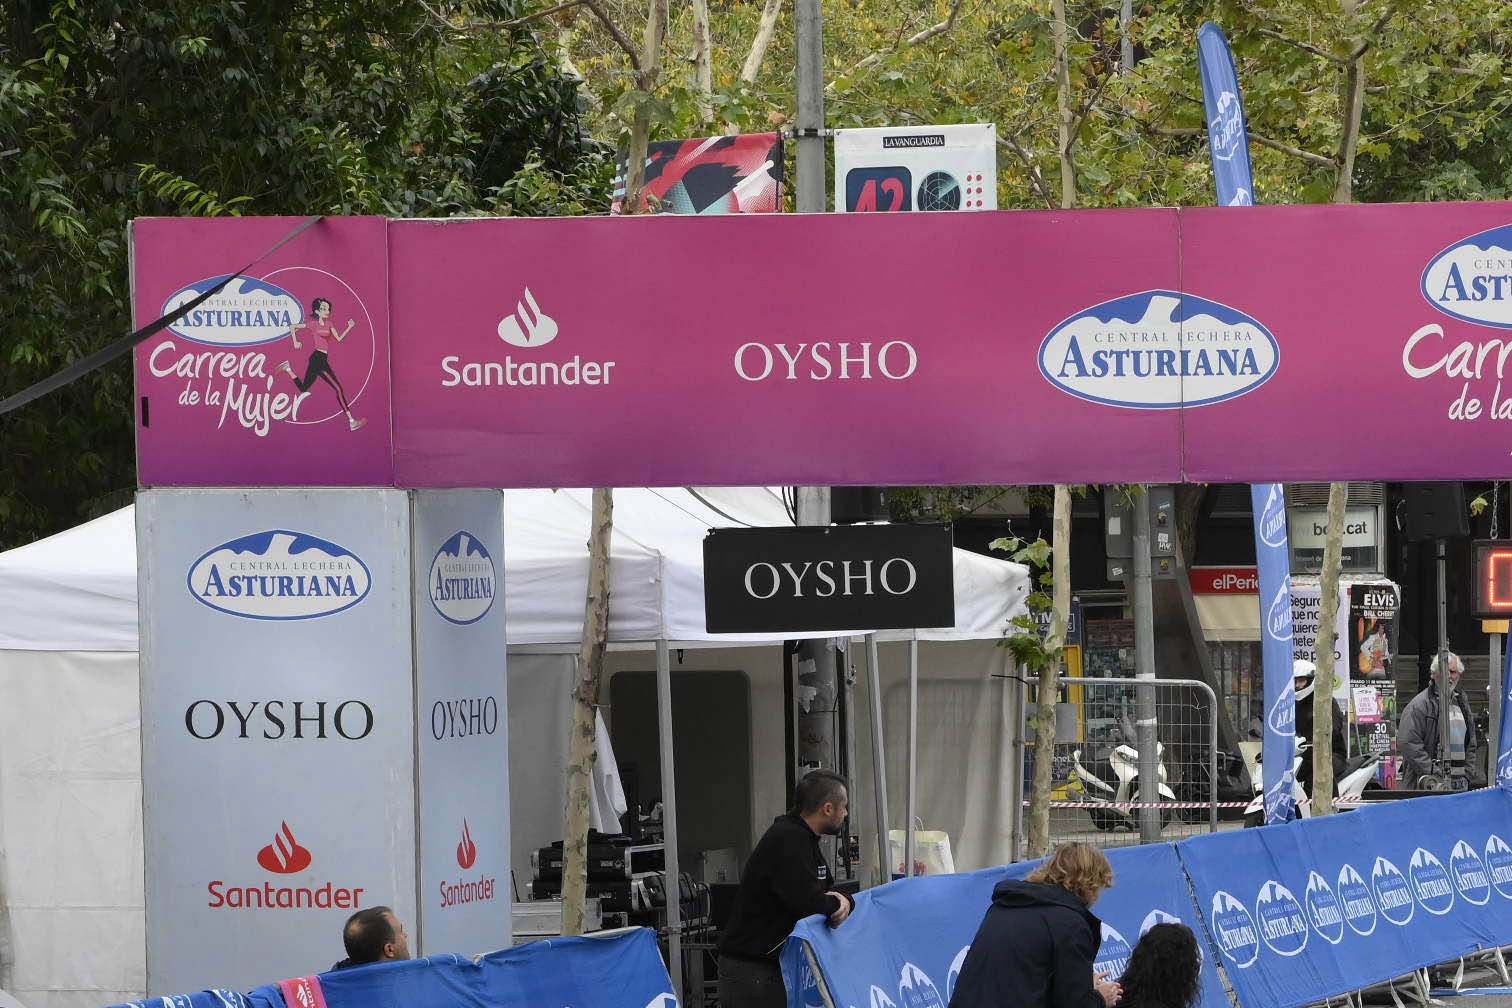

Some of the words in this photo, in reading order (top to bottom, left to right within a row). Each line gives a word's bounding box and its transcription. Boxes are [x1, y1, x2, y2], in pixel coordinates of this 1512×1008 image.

[201, 299, 238, 307] ENTRAL
[1094, 331, 1169, 344] CENTRAL
[1177, 330, 1253, 342] LECHERA
[150, 341, 266, 379] Carrera
[441, 356, 615, 387] Santander
[734, 340, 918, 382] OYSHO
[1057, 334, 1261, 379] ASTURIANA
[178, 380, 200, 406] de
[205, 381, 221, 406] la
[217, 376, 311, 437] Mujer
[1448, 382, 1483, 420] de
[202, 563, 359, 598] ASTURIANA
[230, 562, 288, 572] CENTRAL
[294, 561, 352, 571] LECHERA
[434, 566, 492, 601] ASTURIANA
[744, 557, 917, 599] OYSHO
[1364, 593, 1394, 607] ELVIS
[185, 699, 375, 740] OYSHO
[431, 696, 498, 741] OYSHO
[1374, 723, 1387, 734] 30
[208, 880, 364, 909] Santander
[440, 875, 496, 909] Santander
